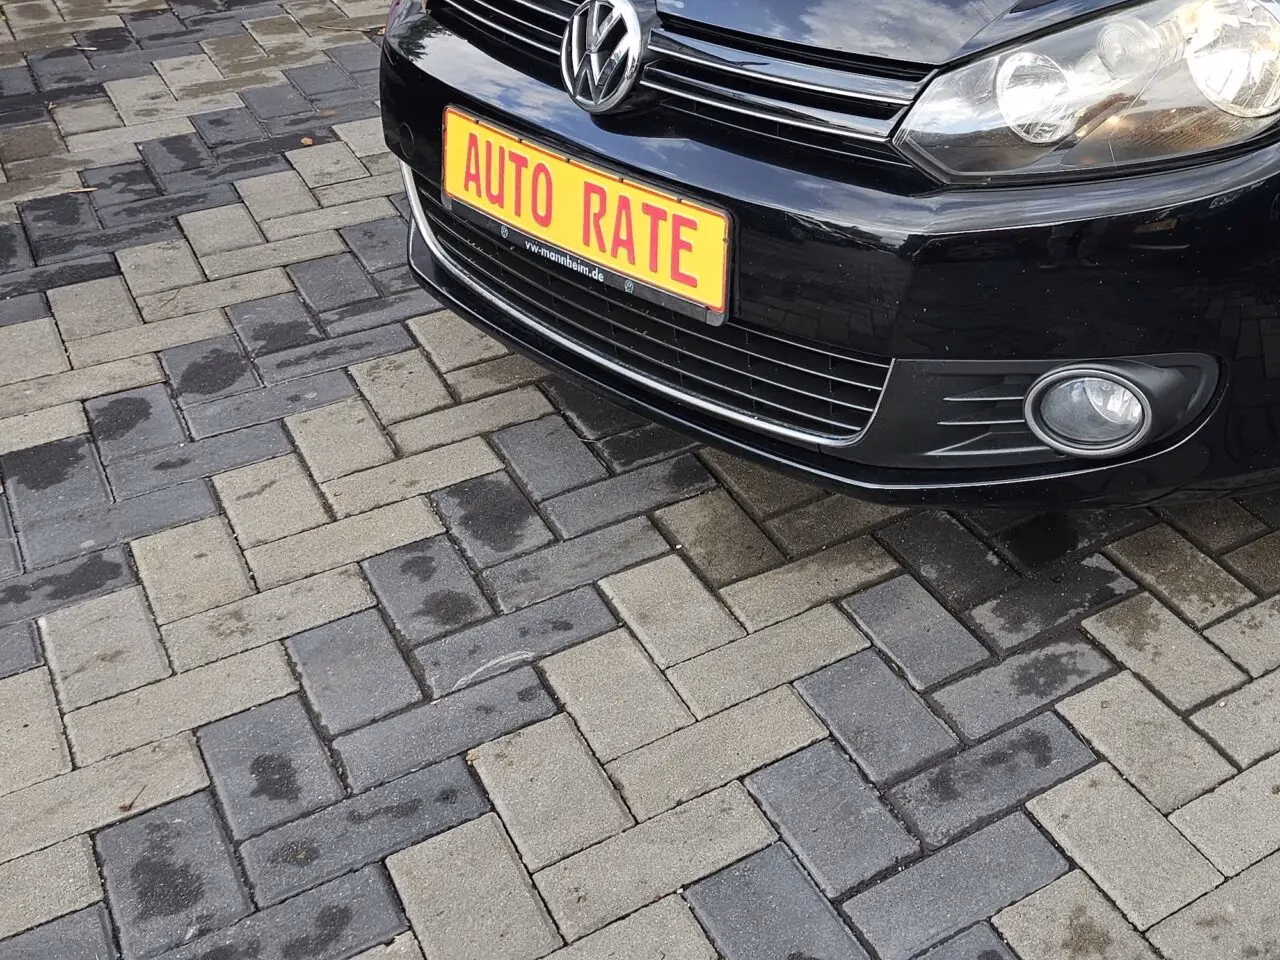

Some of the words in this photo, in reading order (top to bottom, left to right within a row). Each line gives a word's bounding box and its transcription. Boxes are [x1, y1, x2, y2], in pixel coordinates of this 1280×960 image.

[463, 132, 553, 228] AUTO
[581, 180, 699, 289] RATE
[524, 240, 605, 283] vw-mannheim.de
